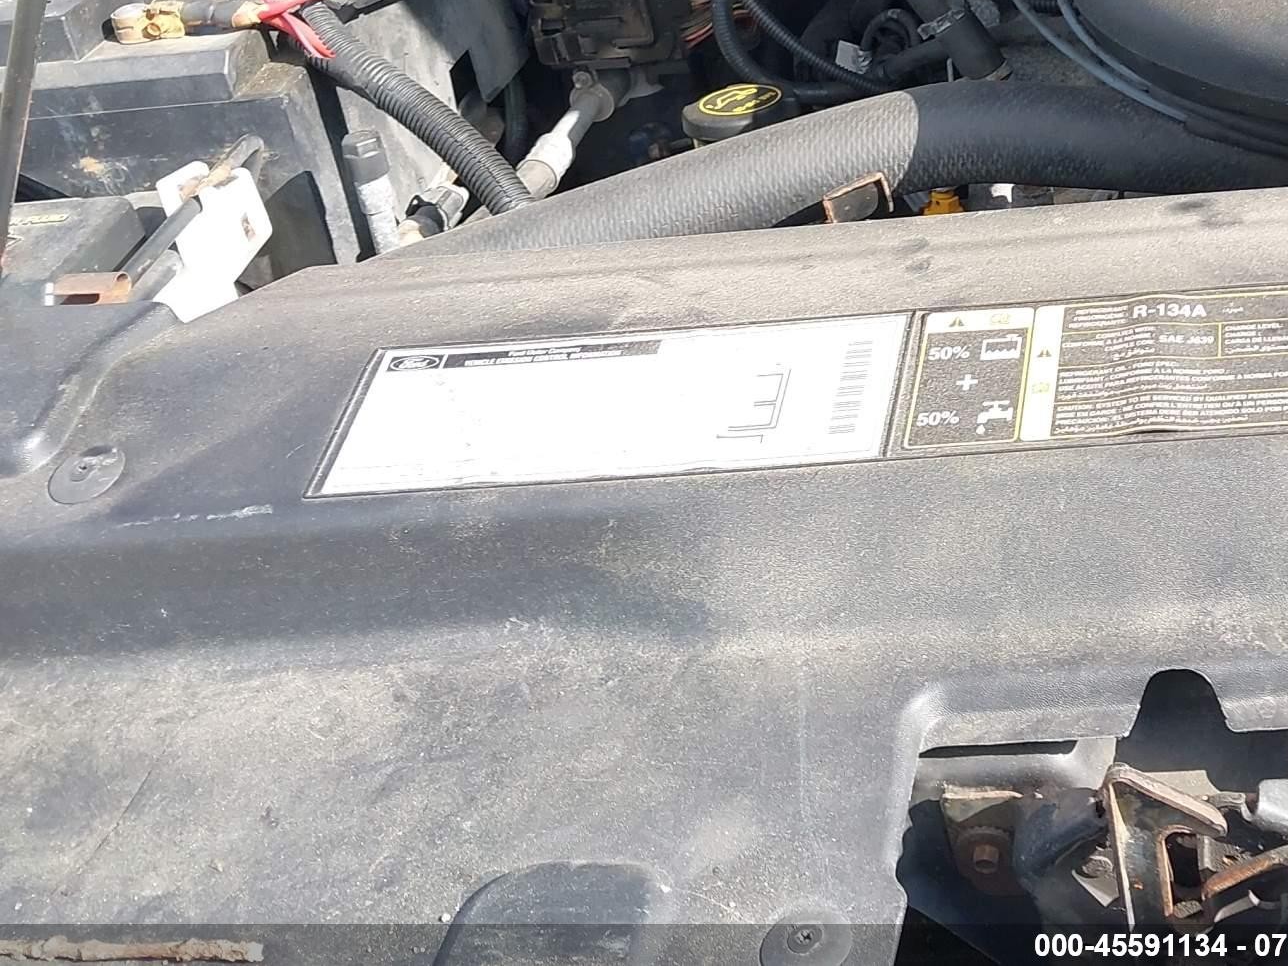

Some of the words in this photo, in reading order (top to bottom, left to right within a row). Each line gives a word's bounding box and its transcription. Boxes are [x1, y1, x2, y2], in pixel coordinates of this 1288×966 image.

[1132, 303, 1207, 319] R-134A
[1158, 335, 1185, 344] SAE
[927, 345, 970, 361] 50%
[916, 410, 960, 427] 50%
